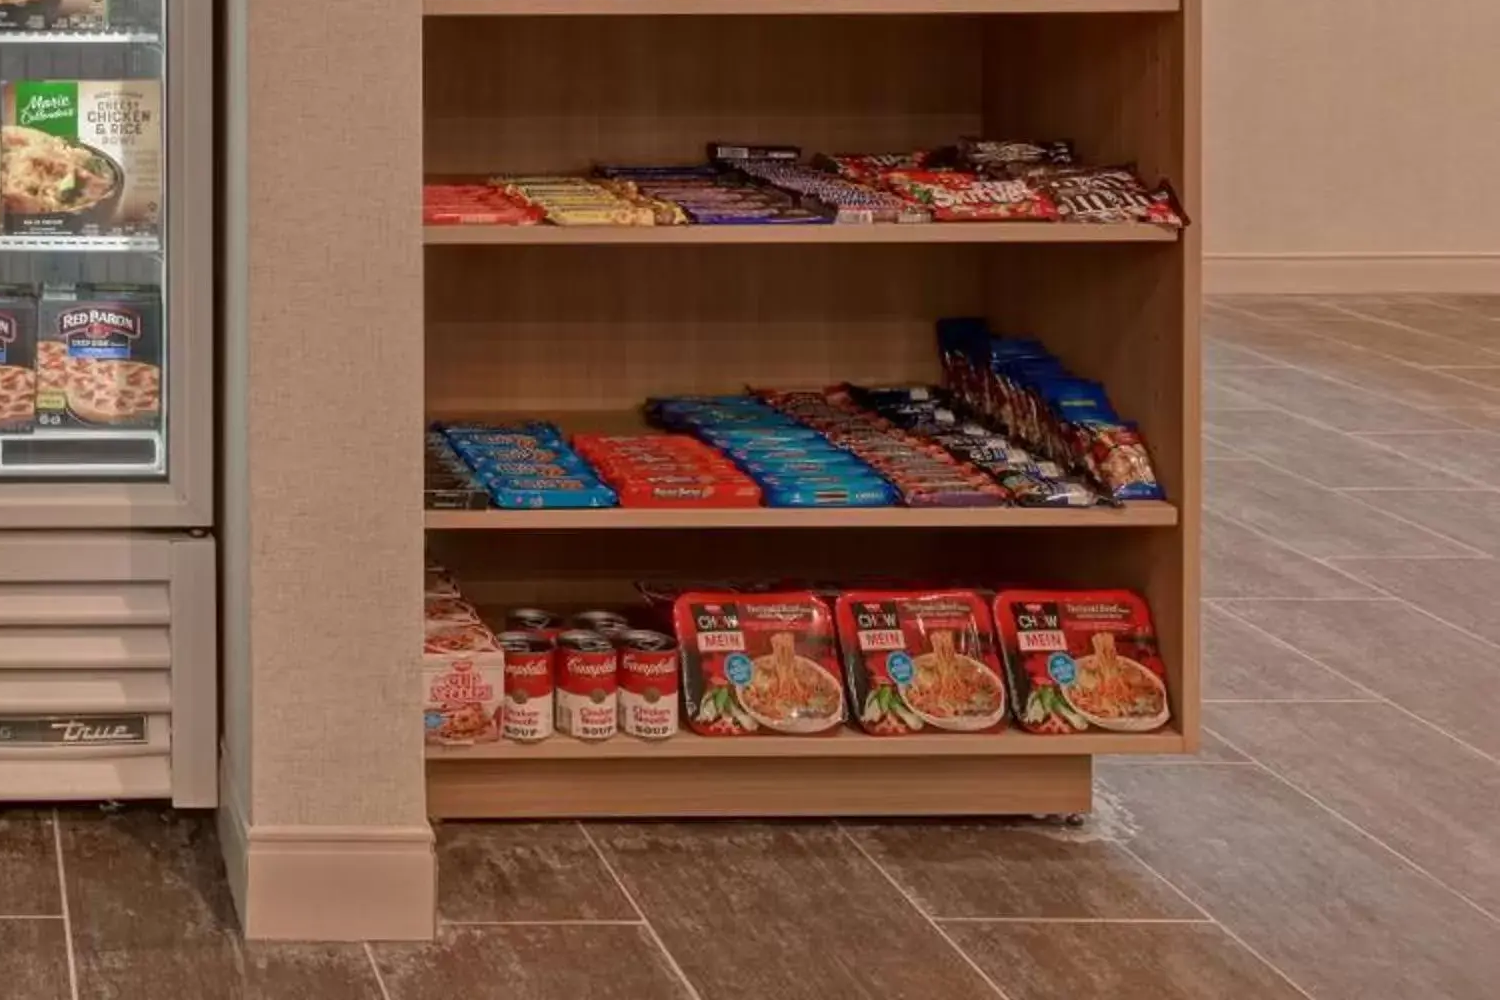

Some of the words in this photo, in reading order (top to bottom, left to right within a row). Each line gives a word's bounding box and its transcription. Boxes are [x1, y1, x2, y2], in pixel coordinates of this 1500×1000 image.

[28, 95, 70, 109] Marie
[87, 111, 151, 122] CHICKEN
[110, 124, 142, 134] RICE
[63, 312, 88, 328] RED
[89, 310, 133, 329] BARON
[704, 634, 740, 647] MEIN
[866, 633, 899, 646] MEIN
[1025, 633, 1061, 647] MEIN
[582, 726, 615, 736] SOUP
[634, 725, 669, 736] SOUP
